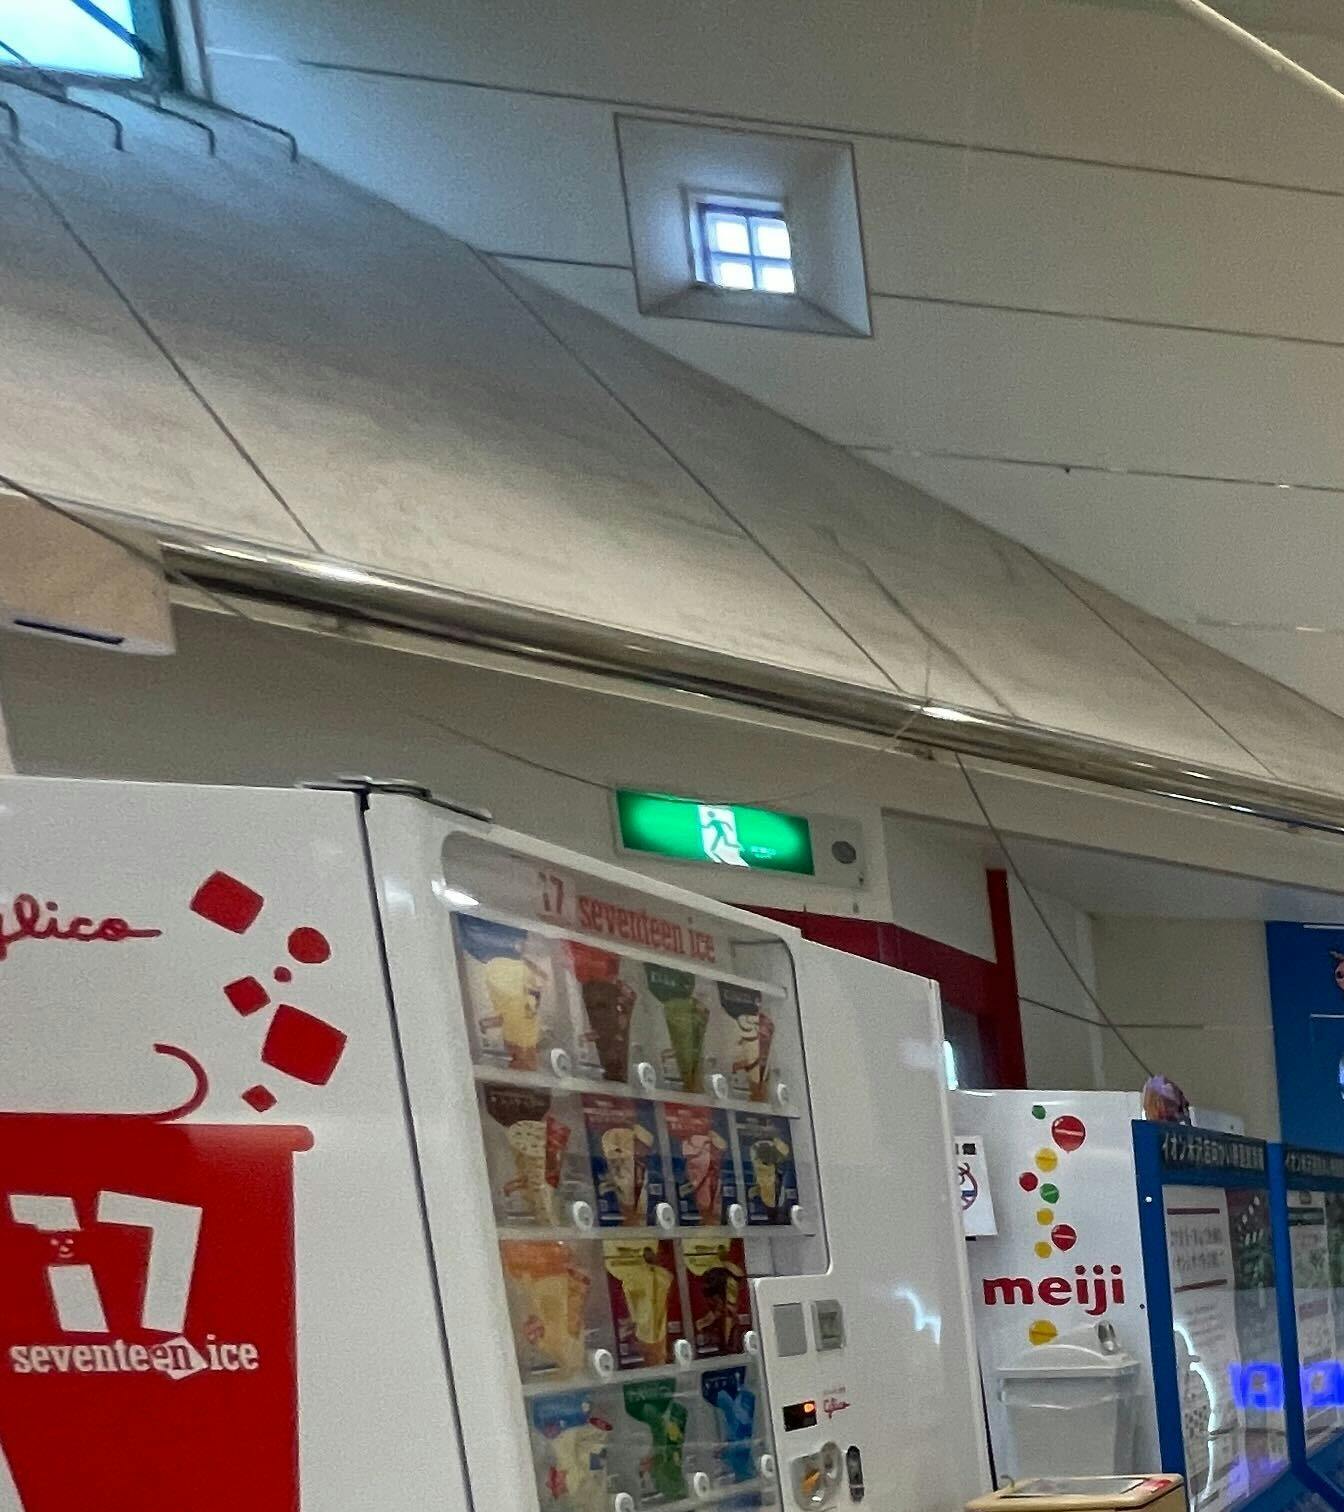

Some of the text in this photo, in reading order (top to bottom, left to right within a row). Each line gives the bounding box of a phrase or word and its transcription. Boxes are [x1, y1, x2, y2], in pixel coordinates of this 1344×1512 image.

[578, 896, 684, 955] seventeen
[687, 917, 715, 964] ice
[983, 1264, 1127, 1316] meiji
[9, 1333, 259, 1376] seventeen ice
